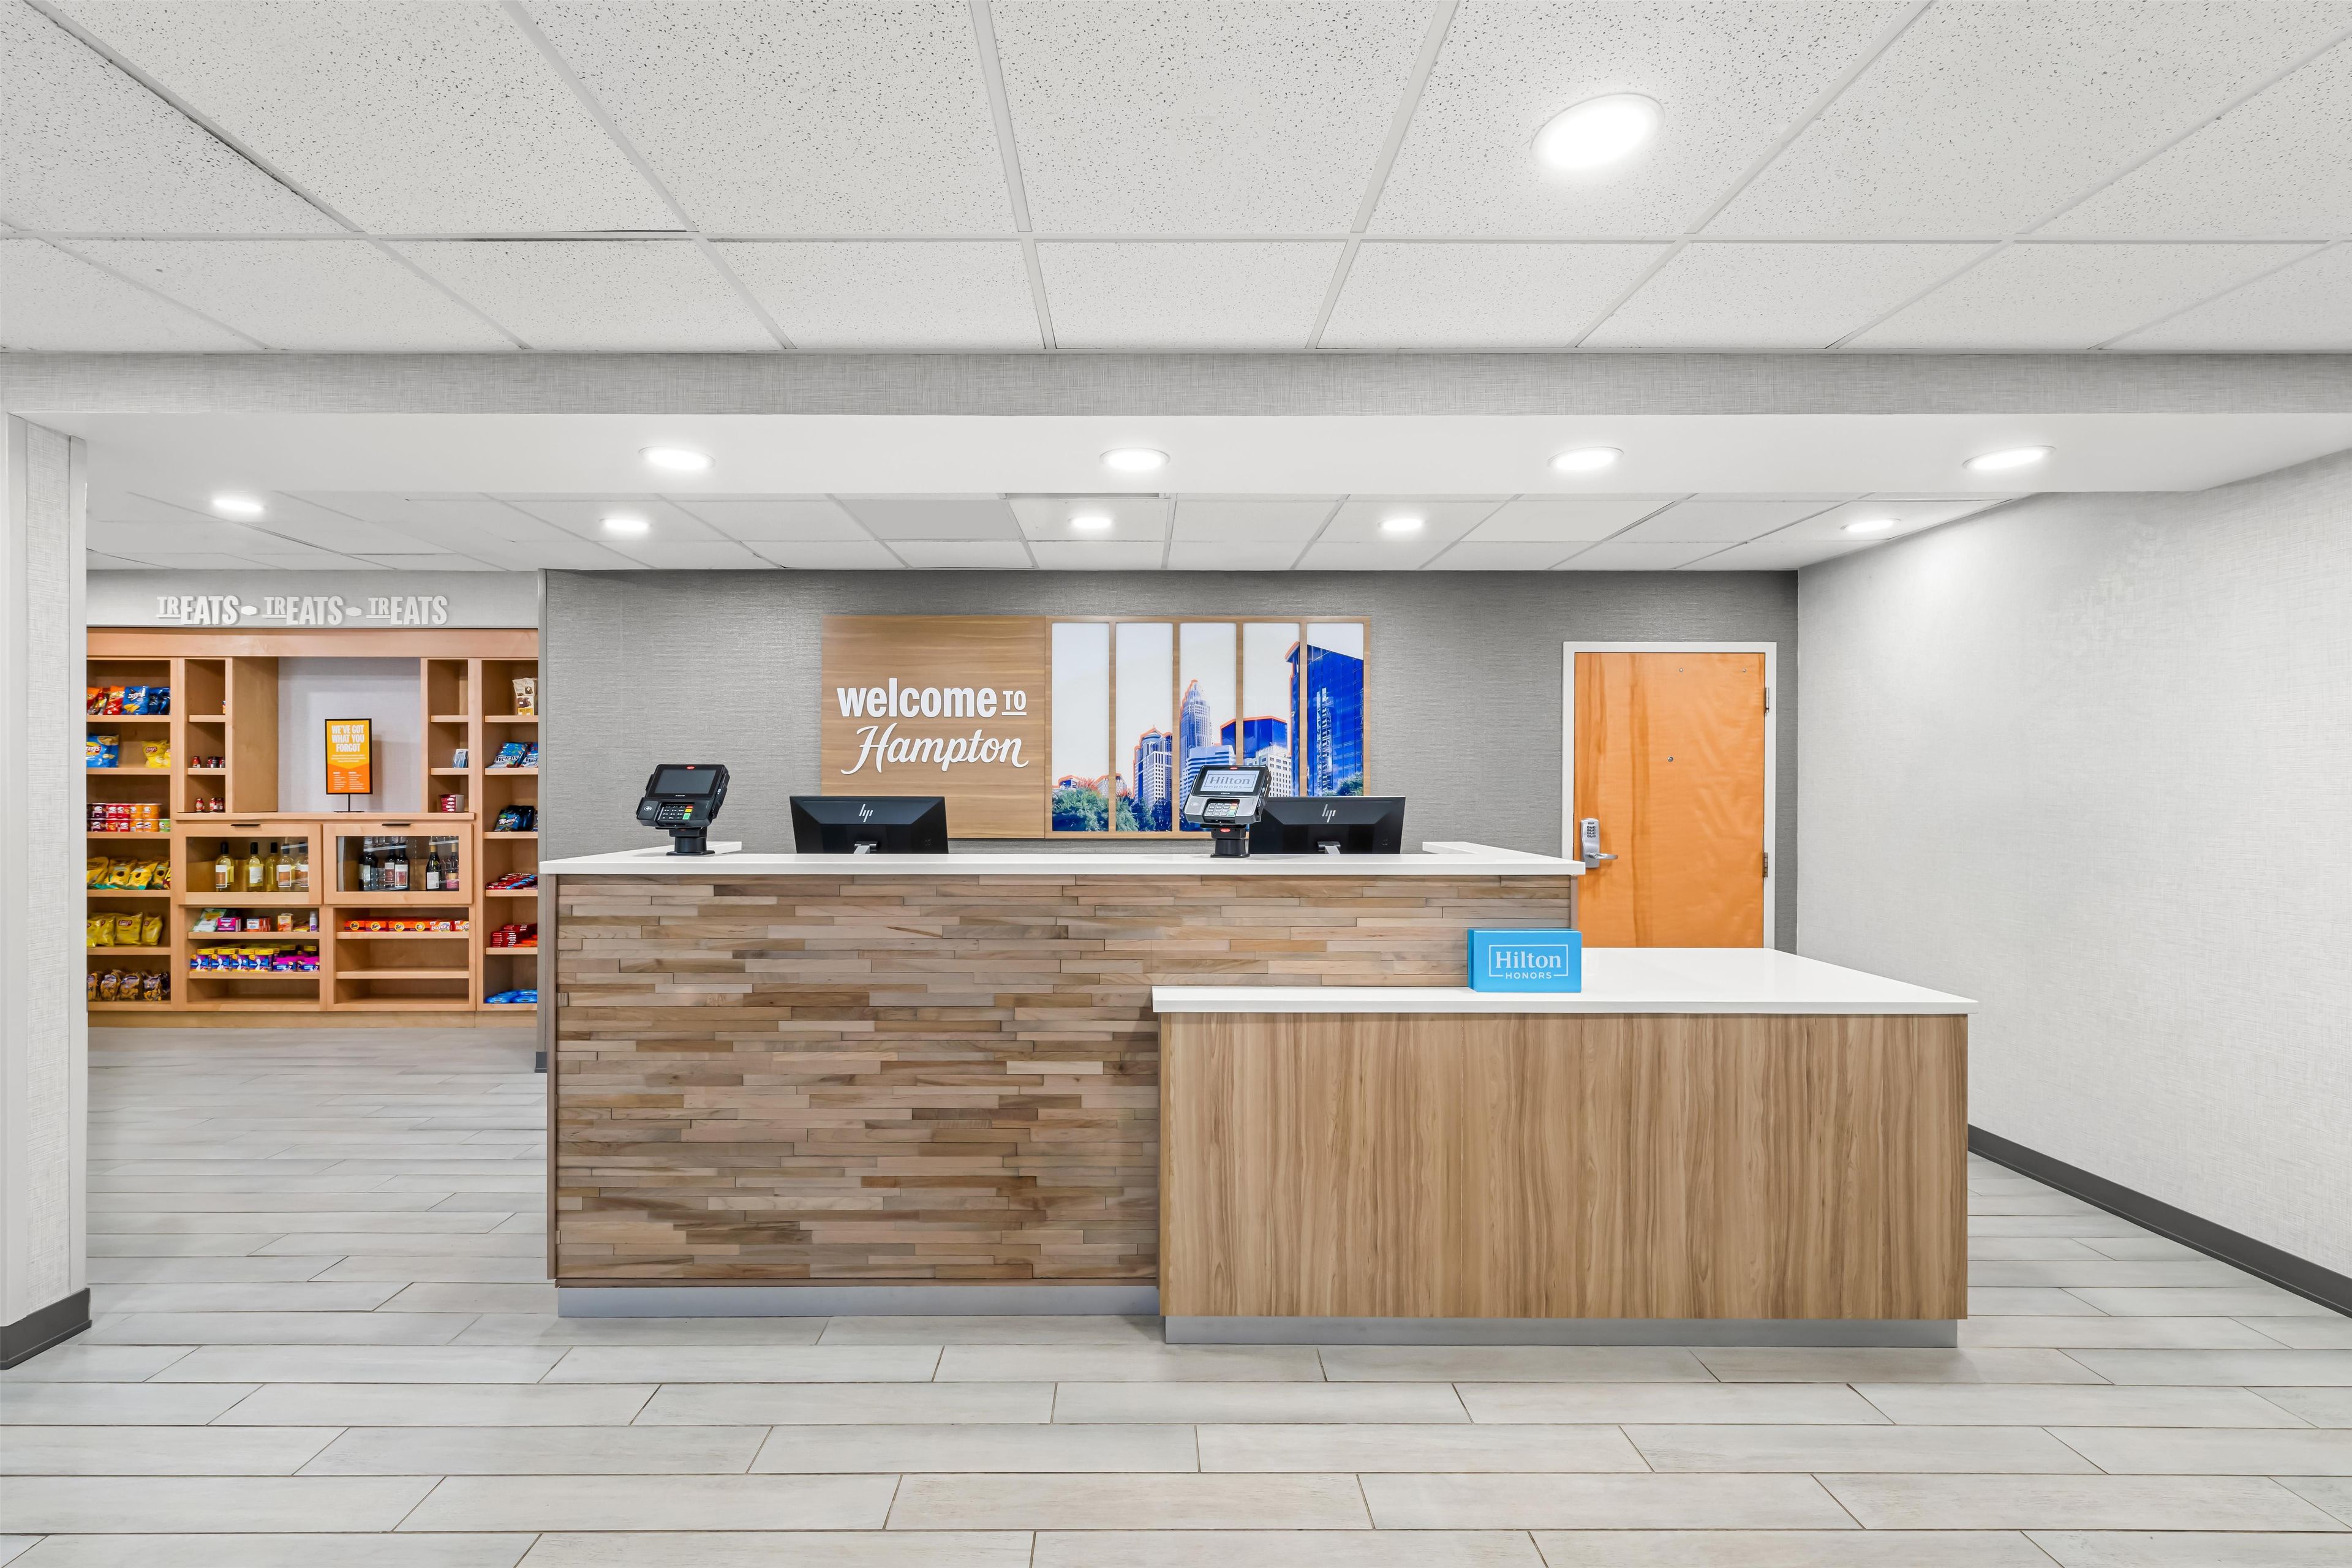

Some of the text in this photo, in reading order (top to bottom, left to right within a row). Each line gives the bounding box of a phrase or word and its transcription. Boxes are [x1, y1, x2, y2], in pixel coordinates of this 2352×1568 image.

[157, 595, 448, 625] TREATS TREATS TREATS
[837, 677, 1027, 718] welcome TO
[331, 725, 364, 734] WE'VE GOT
[331, 734, 365, 743] WHAT YOU
[336, 744, 361, 752] FORGOT
[840, 722, 1029, 775] Hampton
[1210, 776, 1250, 785] Hilton
[1495, 951, 1562, 968] Hilton
